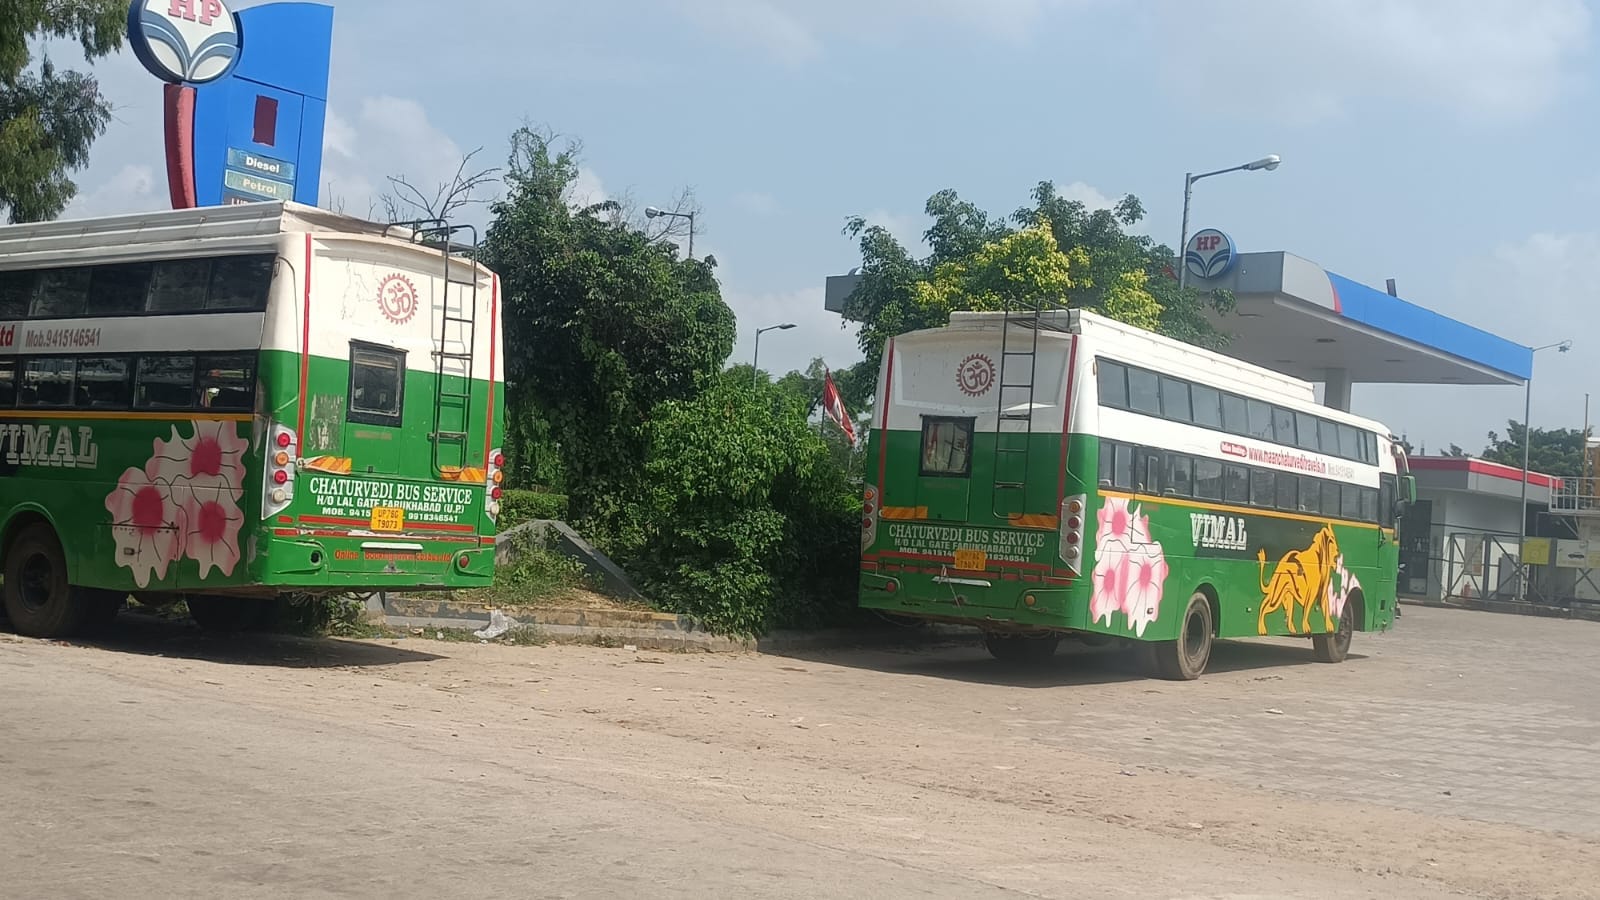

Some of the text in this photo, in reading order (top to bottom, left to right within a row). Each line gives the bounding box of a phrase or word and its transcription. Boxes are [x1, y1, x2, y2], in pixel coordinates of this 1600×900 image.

[168, 0, 222, 26] HP
[245, 155, 280, 174] Diesel
[242, 178, 277, 195] Petrol
[1196, 235, 1222, 251] HP
[309, 477, 473, 505] CHATURVEDI BUS SERVICE
[316, 495, 334, 506] H/O
[336, 497, 354, 507] LAL
[356, 497, 381, 509] GATE
[322, 507, 346, 516] MOB.
[408, 512, 459, 523] 9918346541
[889, 524, 1045, 548] CHATURVEDI BUS SERVICE
[1190, 512, 1248, 551] VIMAL
[894, 537, 909, 547] H/O
[911, 538, 927, 548] LAL
[928, 540, 951, 550] GATE
